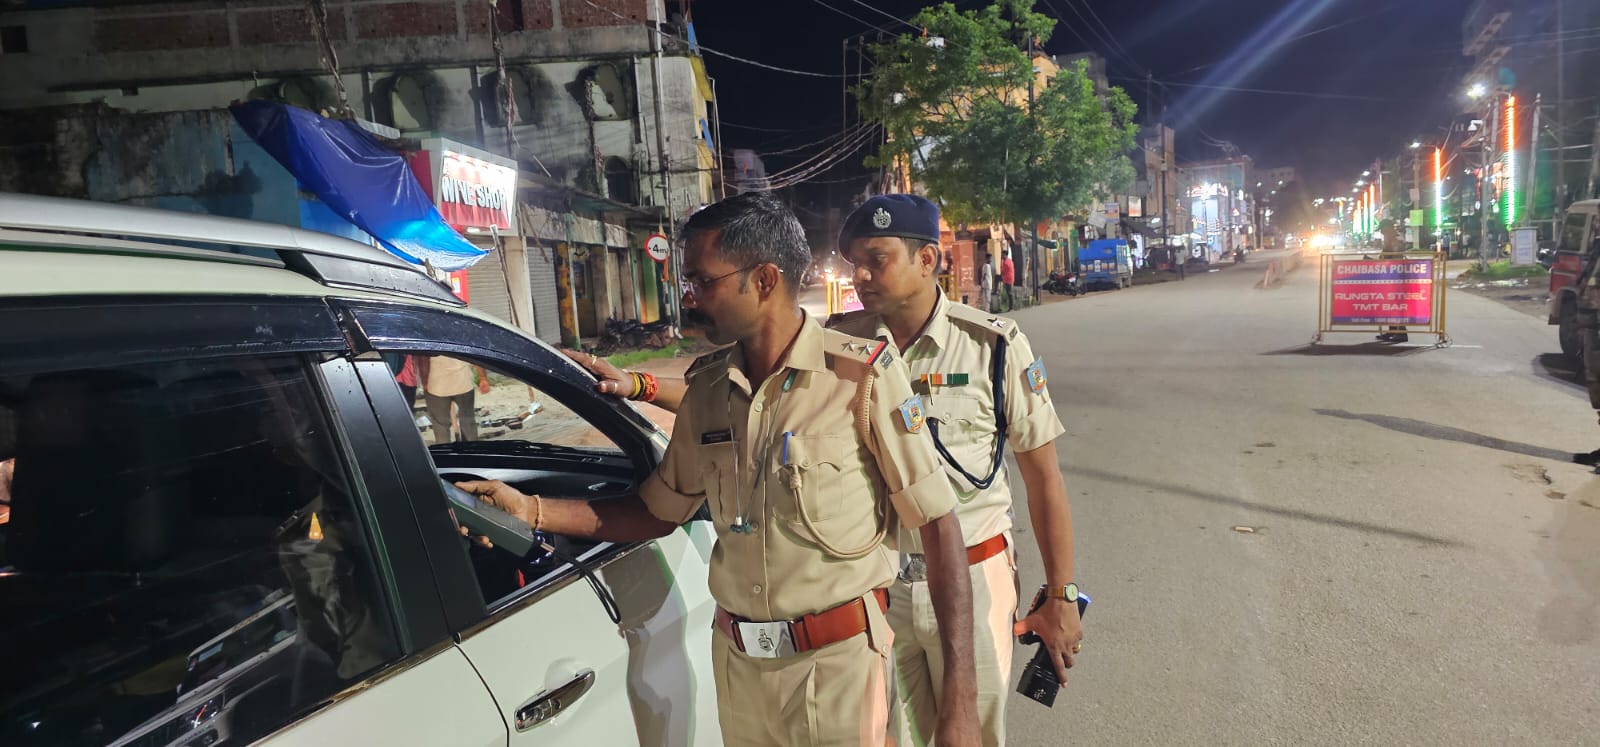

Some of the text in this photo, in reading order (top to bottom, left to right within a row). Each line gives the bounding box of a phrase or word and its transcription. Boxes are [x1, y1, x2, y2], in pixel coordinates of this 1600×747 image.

[1337, 263, 1427, 274] CHAIBASA POLICE
[1334, 290, 1428, 301] RUNGTA STEEL
[1352, 303, 1408, 311] TMT BAR
